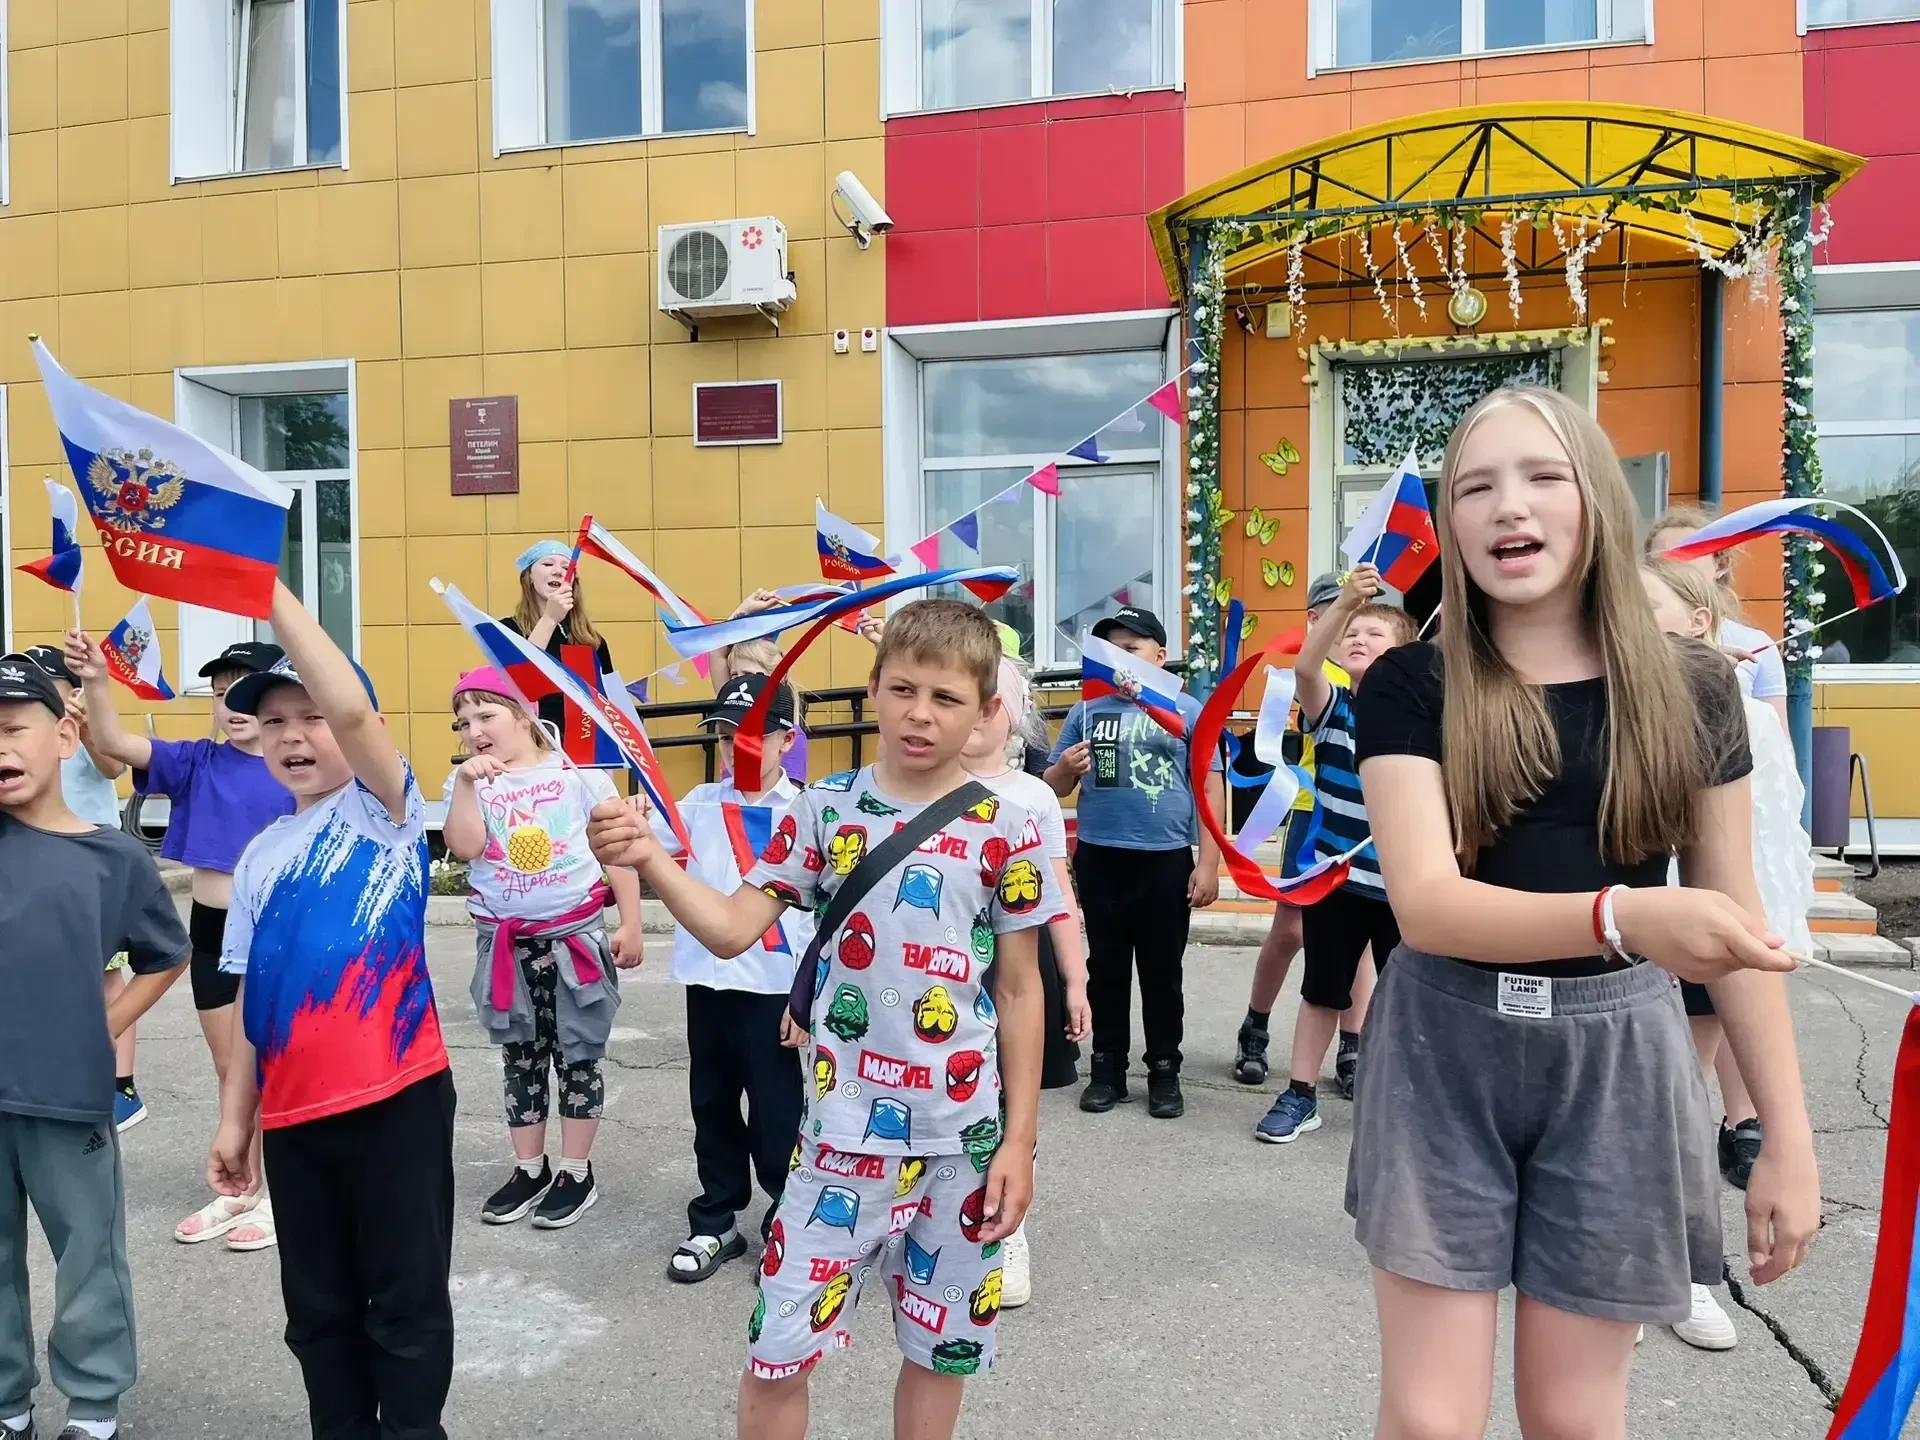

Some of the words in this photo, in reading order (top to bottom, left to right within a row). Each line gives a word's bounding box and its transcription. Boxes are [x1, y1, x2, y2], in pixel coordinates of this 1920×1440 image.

[825, 558, 861, 575] РОССИЯ
[104, 643, 142, 685] РОССИЯ
[1093, 720, 1119, 741] 4U
[1095, 748, 1116, 759] YEAH
[1096, 758, 1116, 768] YEAH
[479, 779, 566, 820] Summer
[502, 872, 561, 902] Aloha
[902, 942, 970, 983] MARVEL
[1504, 976, 1544, 987] FUTURE
[1511, 985, 1538, 994] LAND
[858, 1049, 934, 1090] MARVEL
[815, 1149, 885, 1180] MARVEL
